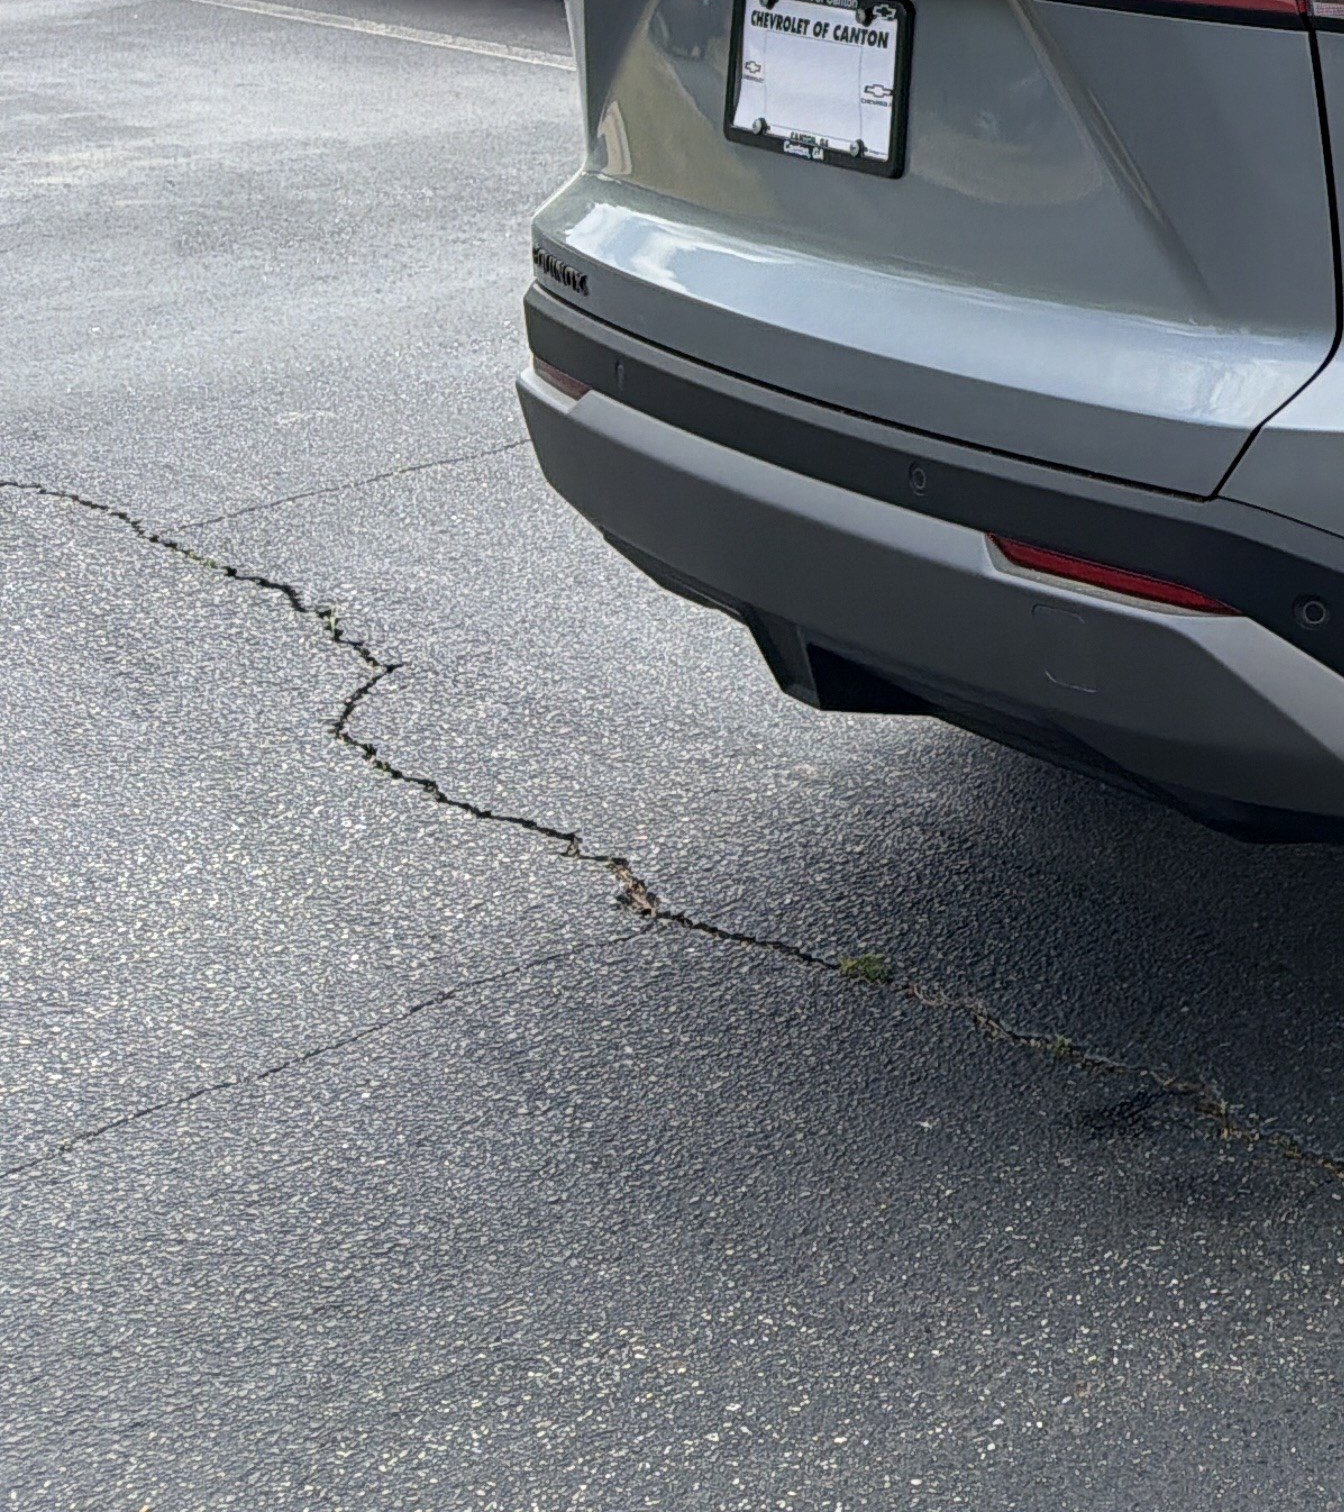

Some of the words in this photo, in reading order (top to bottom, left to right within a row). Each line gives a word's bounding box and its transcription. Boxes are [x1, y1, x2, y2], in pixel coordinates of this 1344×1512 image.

[751, 9, 810, 35] CHEVROLET
[812, 20, 830, 38] OF
[833, 23, 890, 49] CANTON
